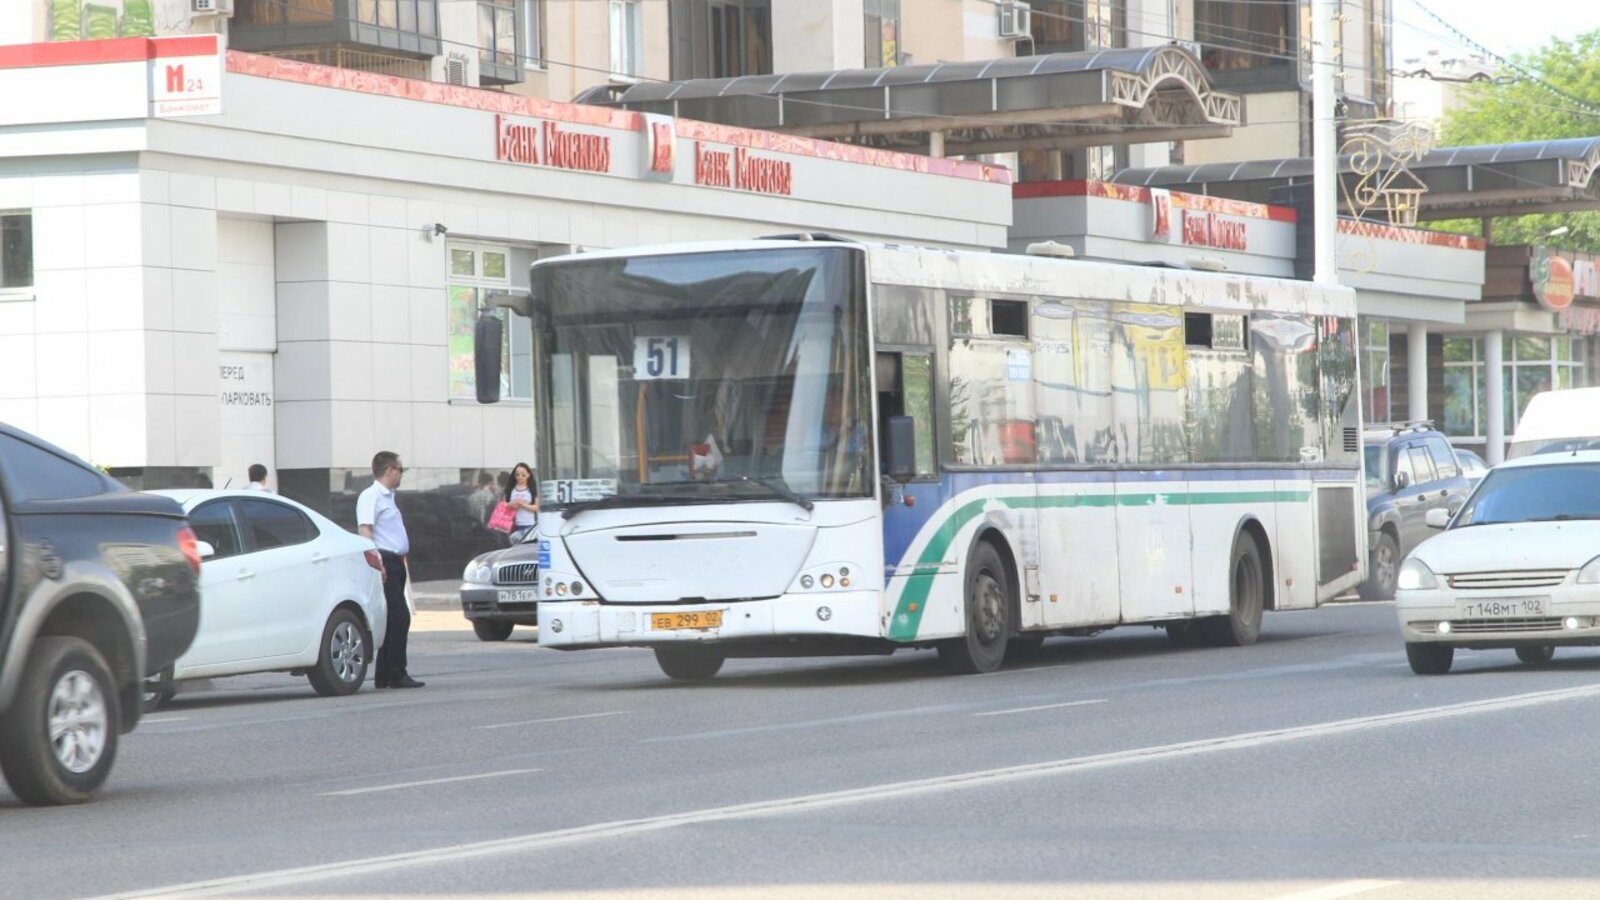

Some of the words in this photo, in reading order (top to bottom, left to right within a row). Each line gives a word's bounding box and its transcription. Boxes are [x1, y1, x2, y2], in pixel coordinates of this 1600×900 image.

[187, 79, 203, 92] 24
[495, 113, 539, 164] Банк
[542, 121, 609, 173] Москвы
[695, 141, 730, 187] Банк
[734, 147, 791, 195] Москвы
[647, 337, 678, 377] 51
[557, 480, 573, 504] 51
[1467, 602, 1517, 617] Т148МТ
[1521, 600, 1541, 611] 102
[657, 618, 671, 629] ЕВ
[676, 614, 699, 627] 299
